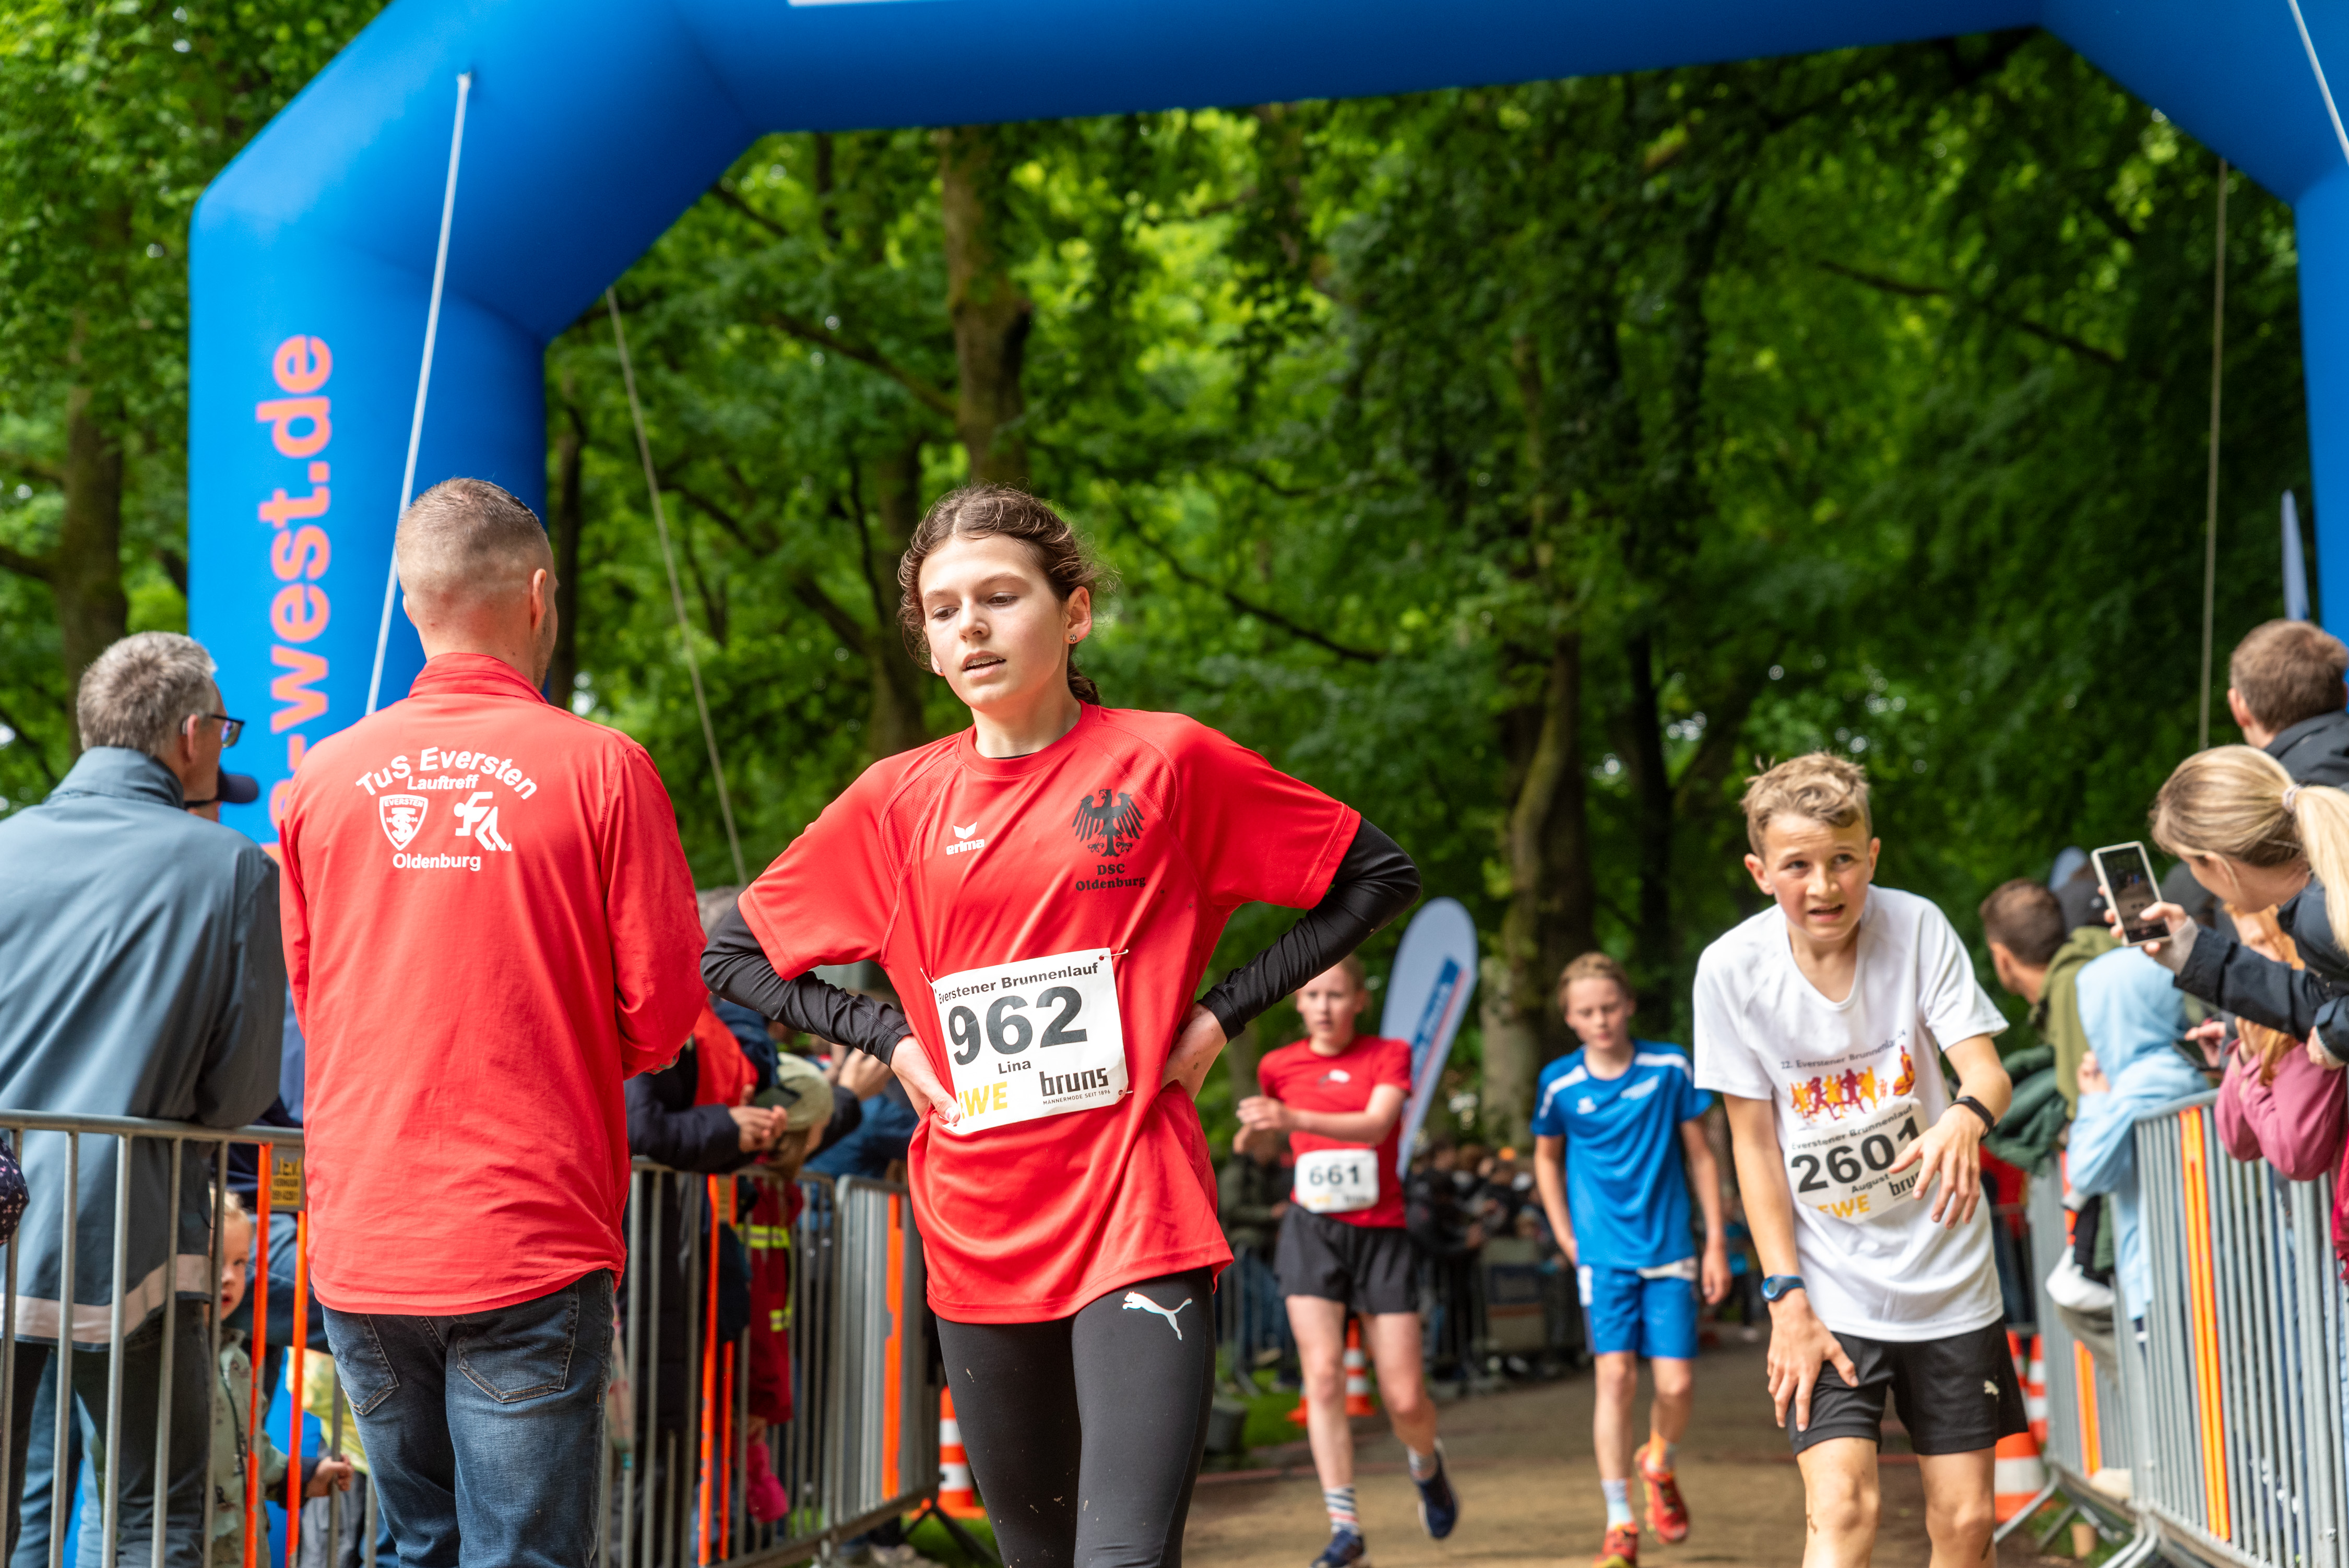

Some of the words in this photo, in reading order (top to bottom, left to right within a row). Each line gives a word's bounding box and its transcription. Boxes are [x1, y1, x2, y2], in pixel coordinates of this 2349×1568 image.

[255, 335, 333, 835] -west.de
[355, 755, 411, 795] TuS
[419, 746, 537, 800] Eversten
[407, 774, 479, 790] Lauftreff
[384, 798, 424, 807] EVERSTEN
[946, 838, 985, 855] erima
[393, 853, 481, 871] Oldenburg
[1097, 863, 1125, 875] DSC
[1075, 877, 1146, 891] Oldenburg
[939, 982, 996, 1005] Everstener
[1001, 962, 1098, 989] Brunnenlauf
[948, 986, 1088, 1065] 962
[1781, 1060, 1793, 1070] 22.
[1796, 1057, 1846, 1068] Everstener
[1849, 1039, 1896, 1061] Brunnenla
[998, 1060, 1031, 1074] Lina
[1039, 1067, 1109, 1097] bruns
[1792, 1134, 1846, 1150] Everstener
[1849, 1103, 1913, 1137] Brunnenlauf
[1791, 1115, 1920, 1194] 2601
[1309, 1165, 1359, 1186] 661
[1852, 1173, 1890, 1194] August
[1888, 1171, 1920, 1196] bru
